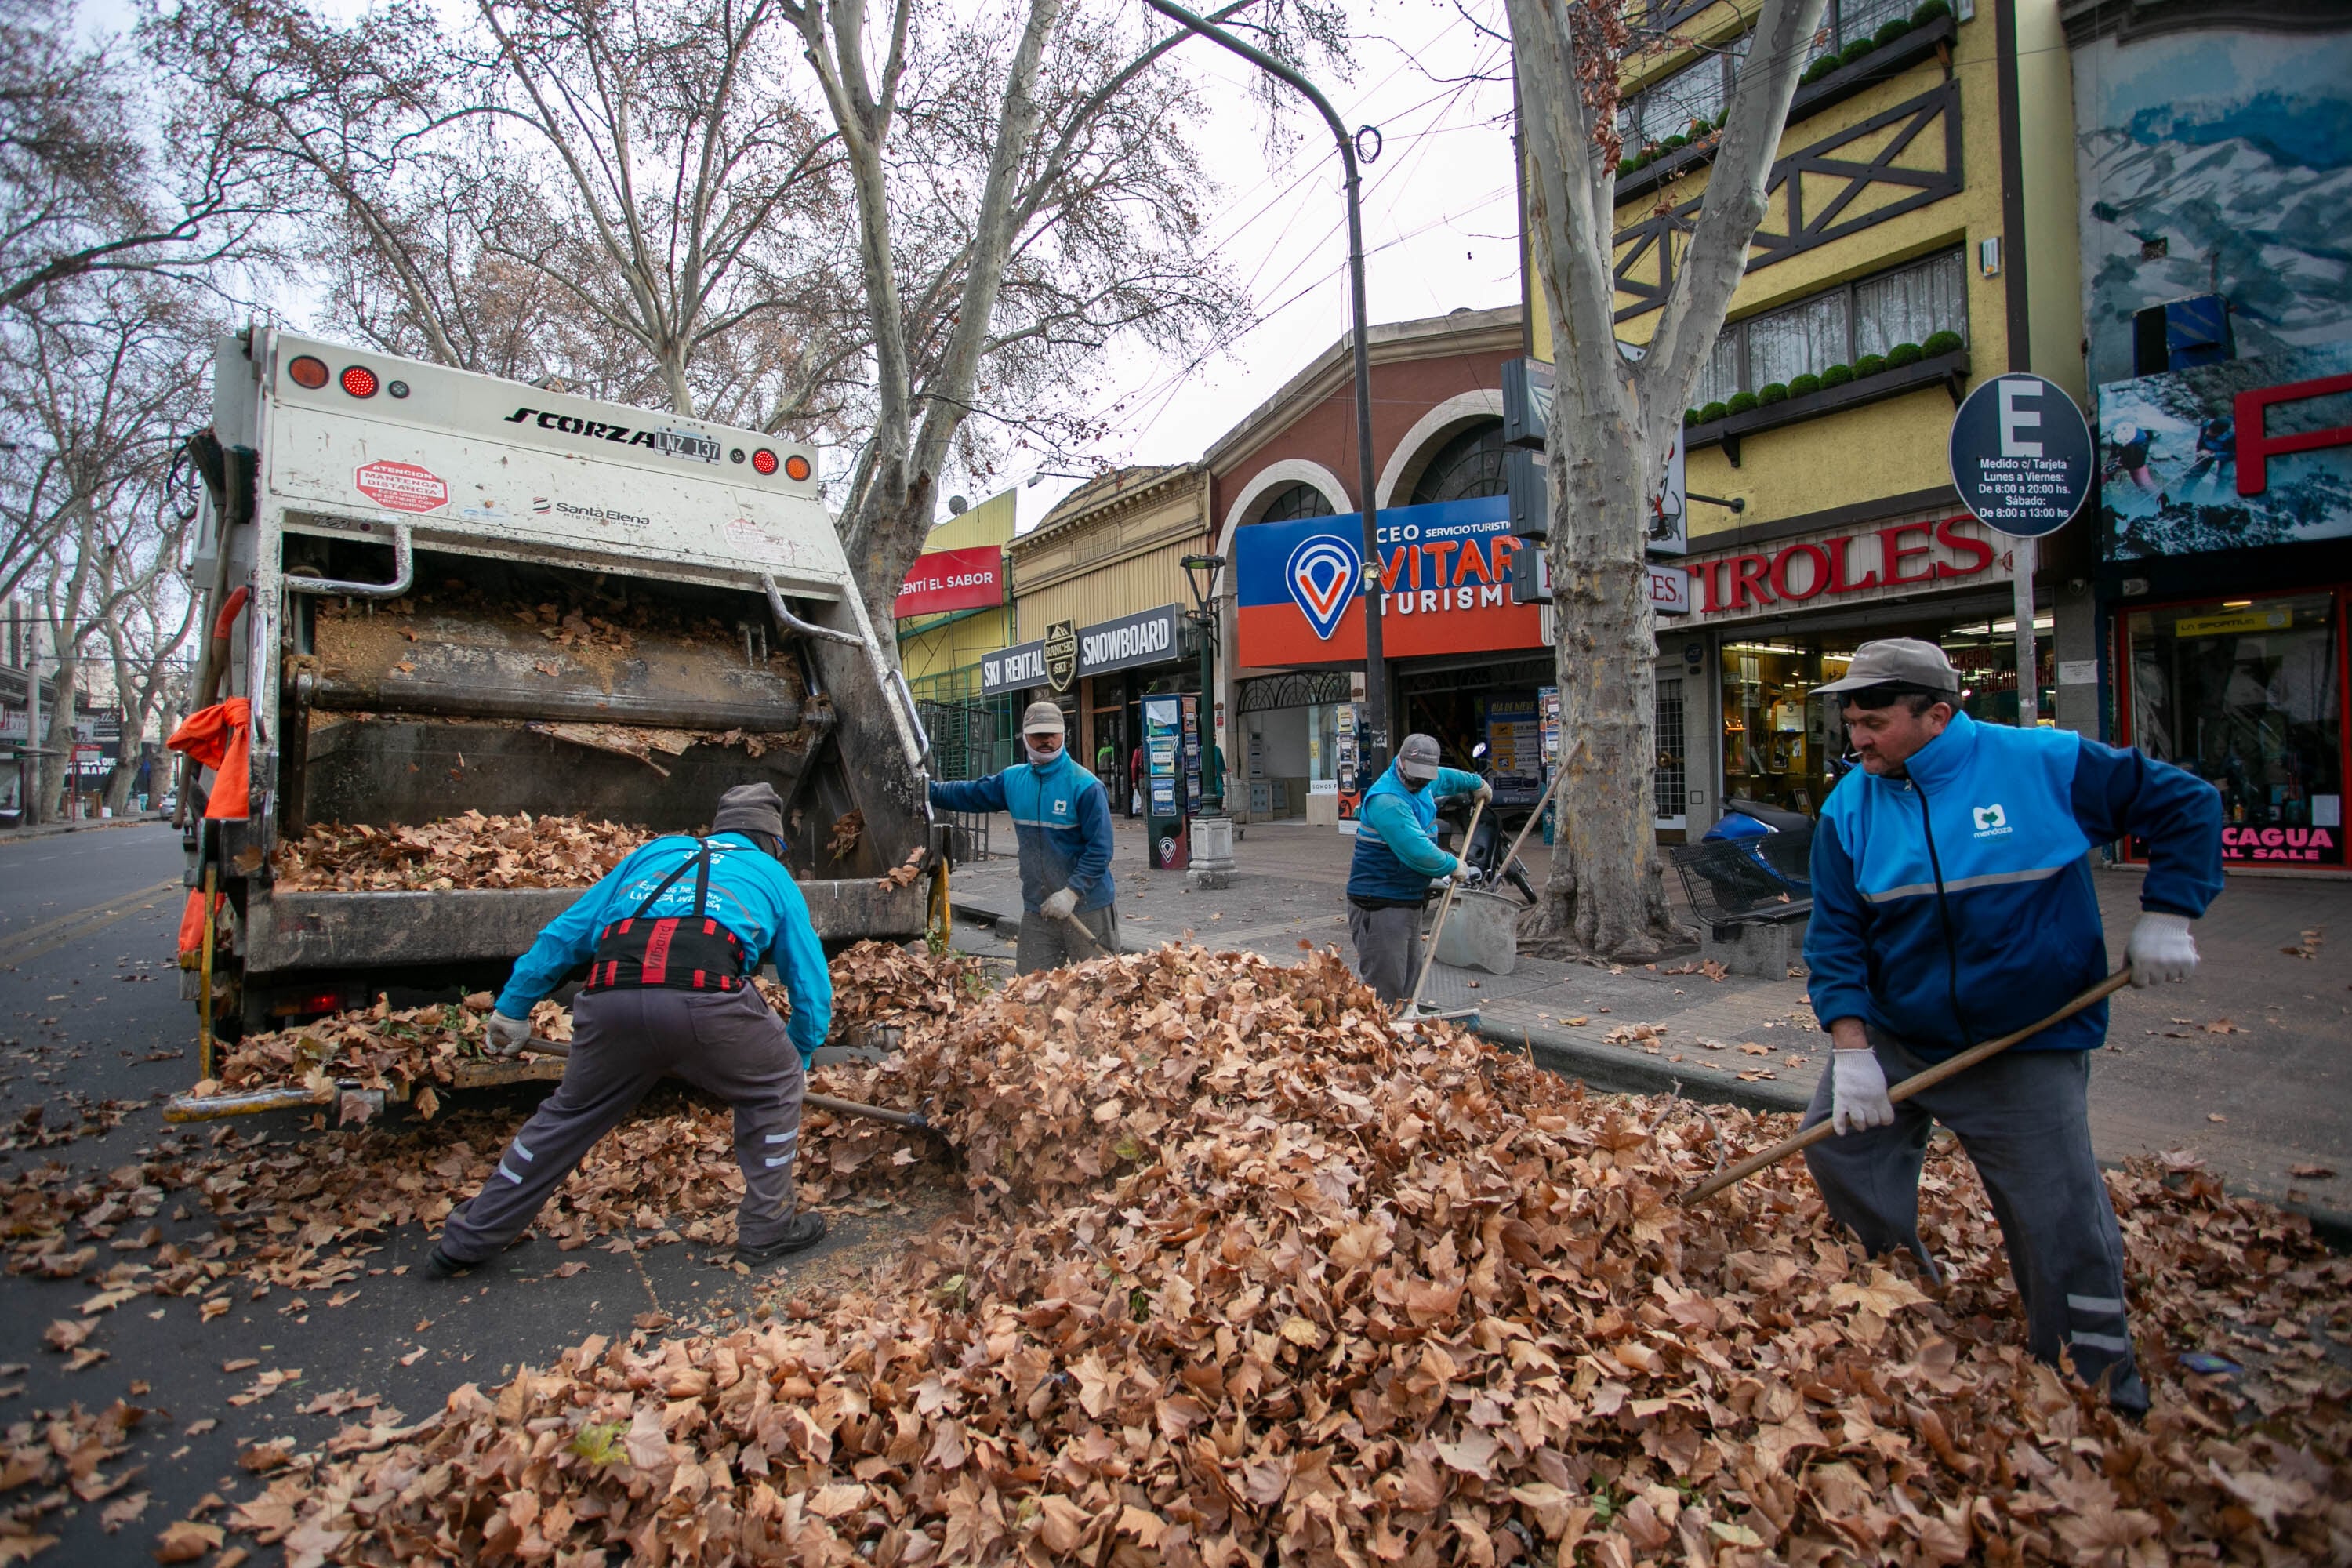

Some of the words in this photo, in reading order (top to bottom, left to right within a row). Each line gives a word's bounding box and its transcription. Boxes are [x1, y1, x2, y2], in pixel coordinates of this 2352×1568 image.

[1998, 380, 2043, 457] E
[504, 407, 655, 449] SCORZA
[657, 433, 684, 453] LNZ
[693, 439, 719, 459] 137
[372, 465, 432, 480] ATENCION
[1980, 459, 2018, 469] Medido
[2033, 459, 2067, 471] Tarjeta
[365, 472, 438, 489] MANTENGA
[1984, 472, 2014, 481] Lunes
[2026, 472, 2064, 481] Viernes:
[368, 480, 437, 495] DISTANCIA
[1979, 484, 1992, 493] De
[1995, 485, 2016, 493] 8:00
[2027, 485, 2053, 493] 20:00
[2056, 485, 2071, 493] hs.
[2005, 495, 2046, 506] Sábado:
[556, 502, 604, 518] Santa
[606, 510, 650, 525] Elena
[1980, 508, 1993, 517] De
[1996, 508, 2017, 517] 8:00
[2029, 508, 2054, 517] 13:00
[2057, 508, 2069, 517] hs
[1377, 524, 1420, 543] CEO
[1425, 527, 1469, 538] SERVICIO
[929, 578, 944, 590] EL
[947, 572, 993, 587] SABOR
[985, 661, 1000, 687] SKI
[1005, 650, 1046, 683] RENTAL
[1083, 618, 1169, 666] SNOWBOARD
[1045, 641, 1074, 657] RANCHO
[1054, 661, 1067, 674] SKI
[2252, 849, 2320, 860] SALE
